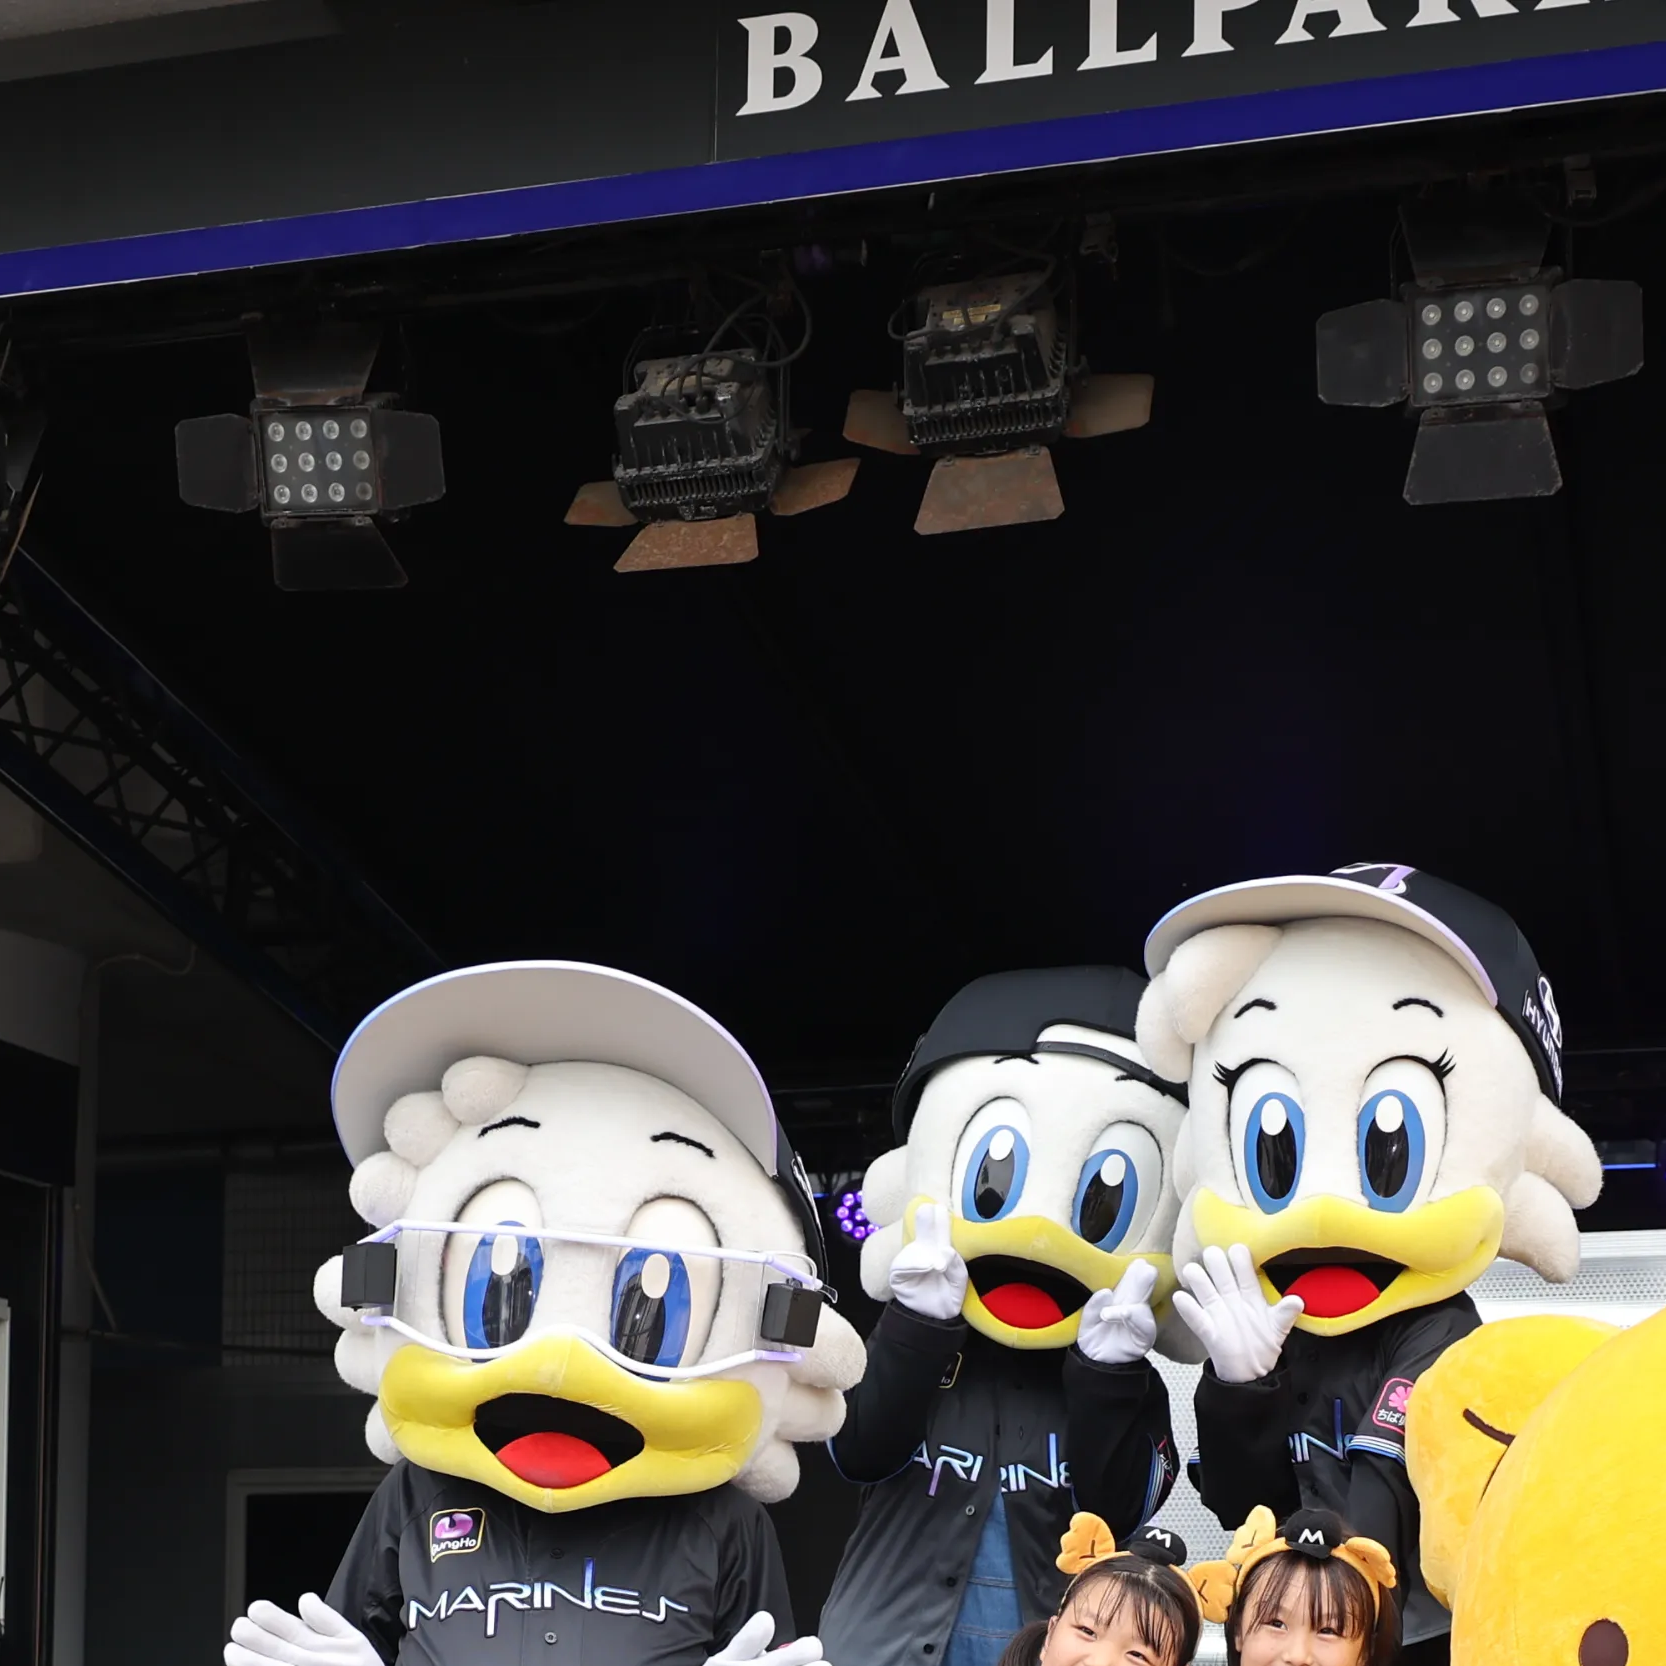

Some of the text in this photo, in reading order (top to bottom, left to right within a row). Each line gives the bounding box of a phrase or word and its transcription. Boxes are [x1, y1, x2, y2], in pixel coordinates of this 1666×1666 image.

[736, 0, 1627, 117] BALLP
[1145, 1528, 1172, 1548] M
[1298, 1528, 1325, 1545] M
[408, 1557, 690, 1638] MARINES
